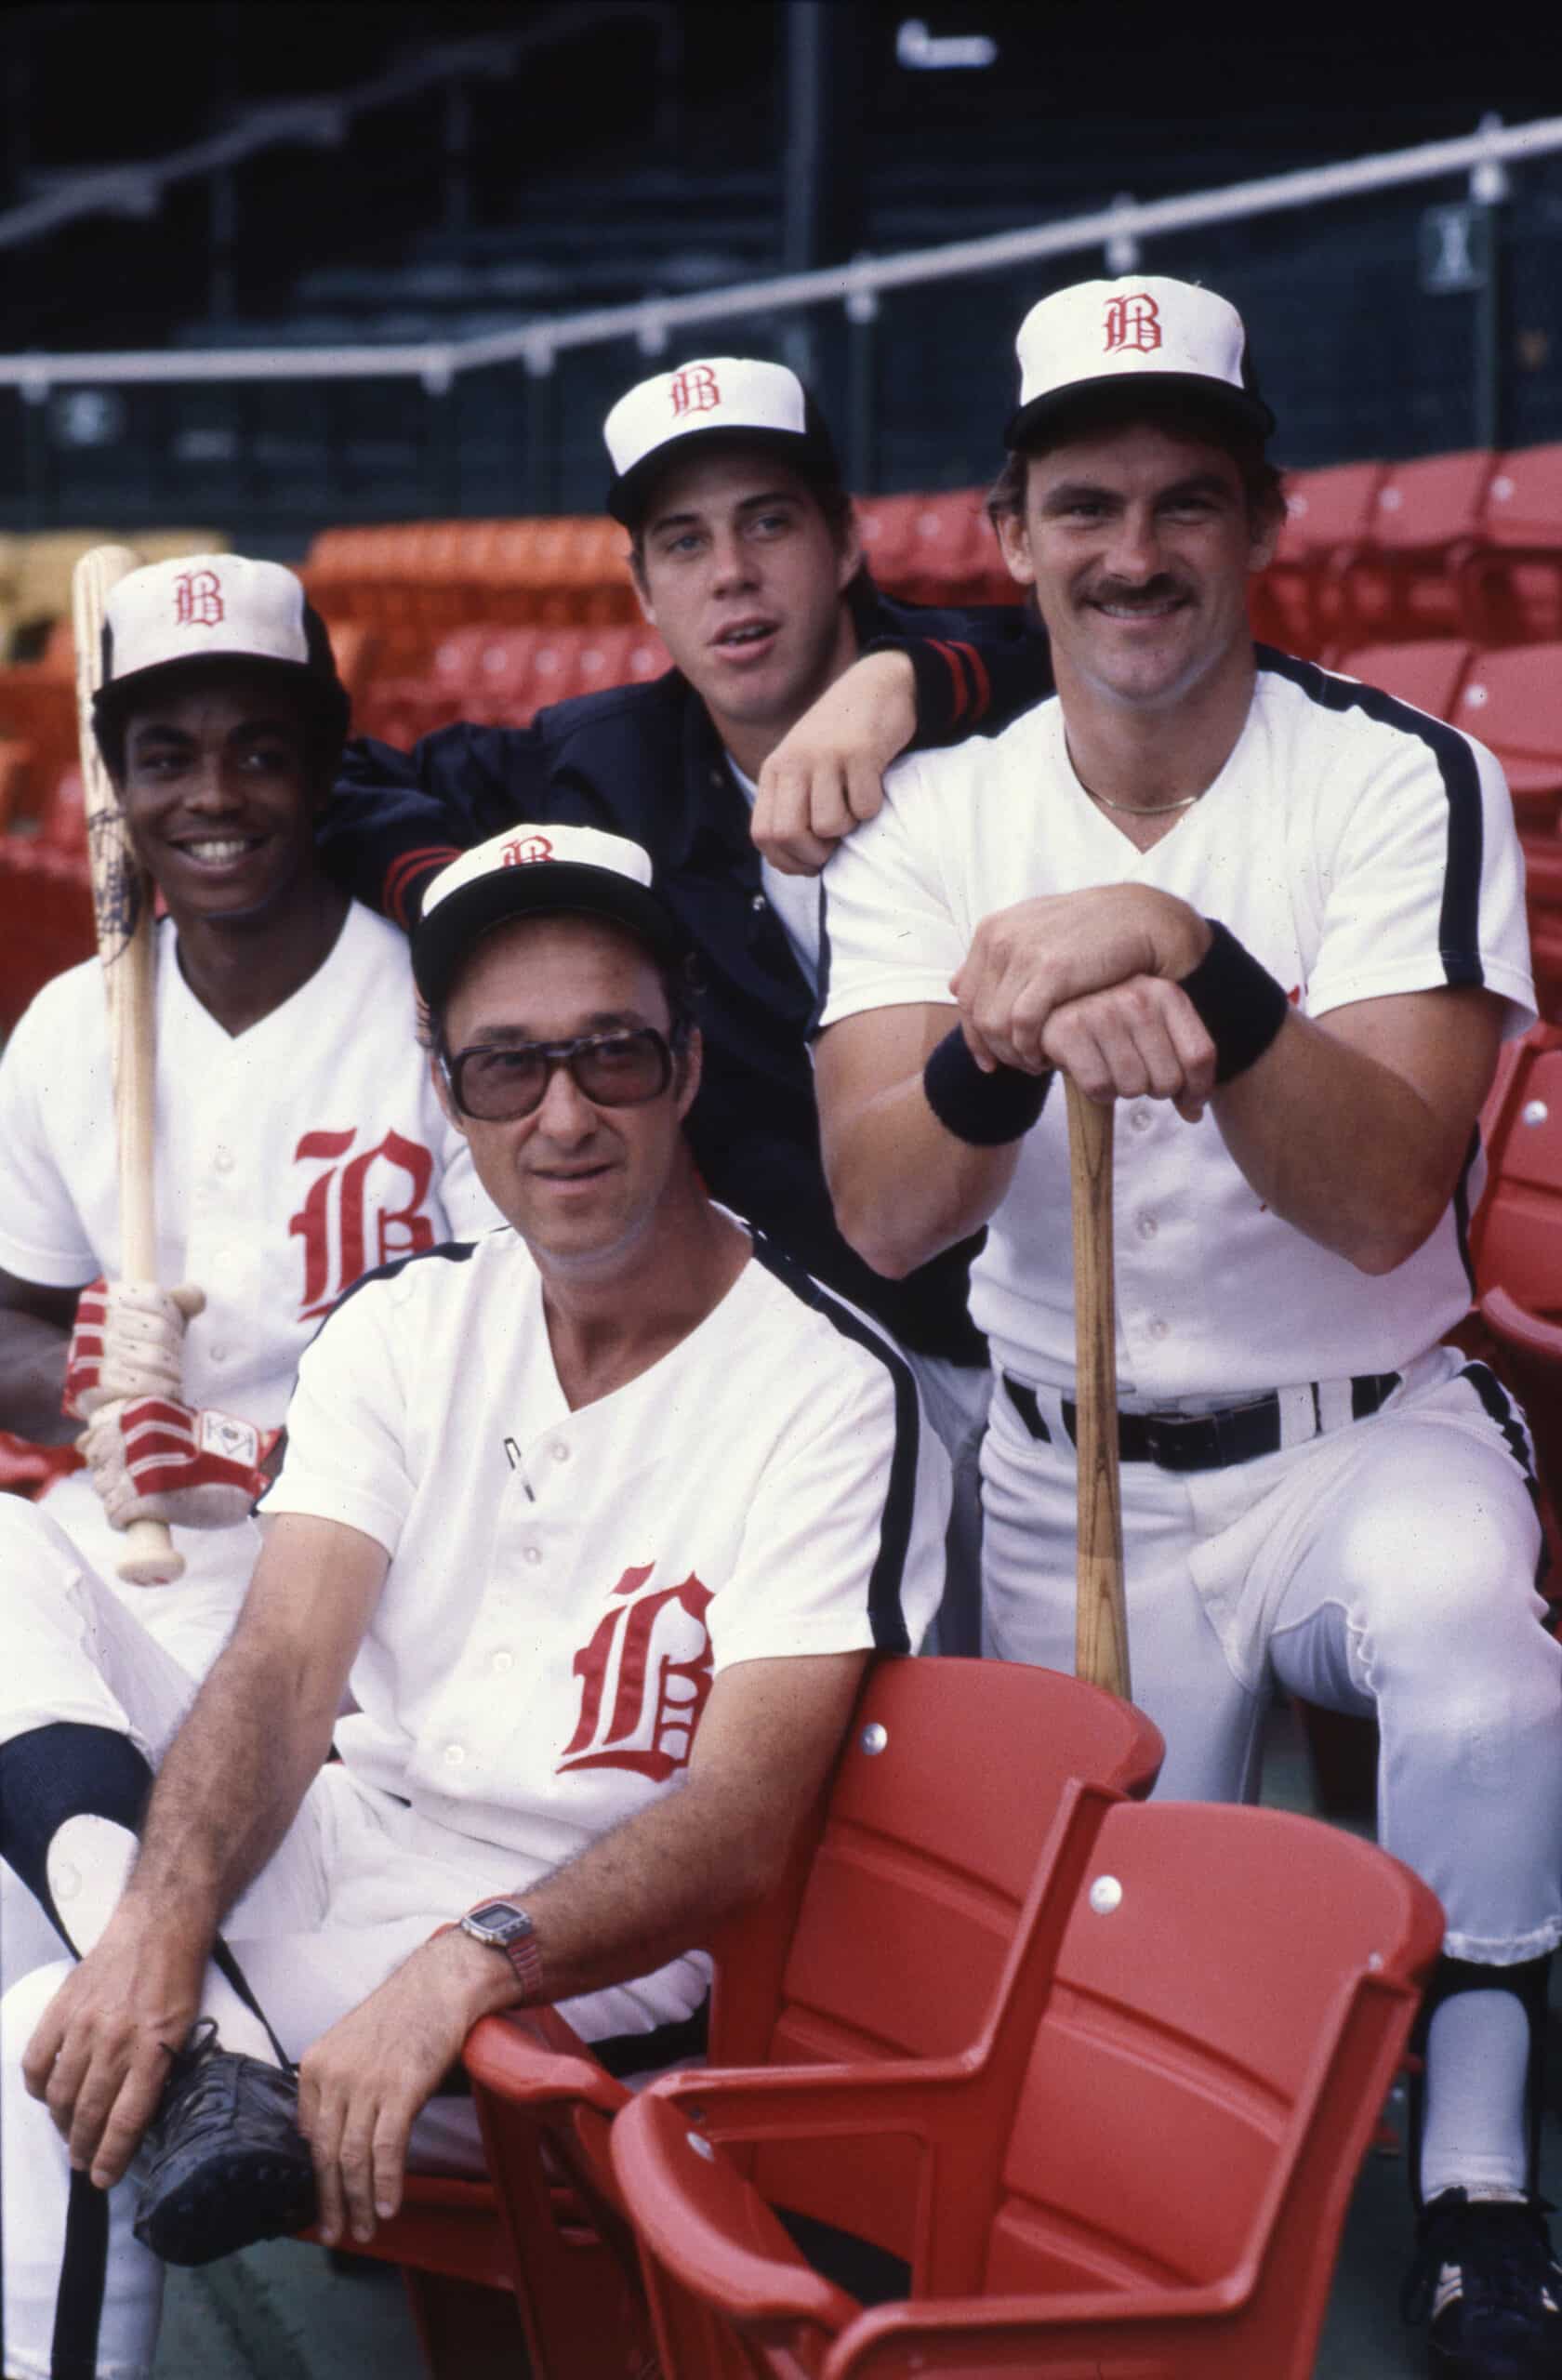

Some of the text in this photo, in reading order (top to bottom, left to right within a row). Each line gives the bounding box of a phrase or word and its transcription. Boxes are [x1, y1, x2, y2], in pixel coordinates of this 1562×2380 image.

[1103, 292, 1161, 353] B
[670, 364, 721, 417] B
[174, 569, 224, 628] B
[288, 1127, 435, 1322] B
[555, 1560, 715, 1782] B
